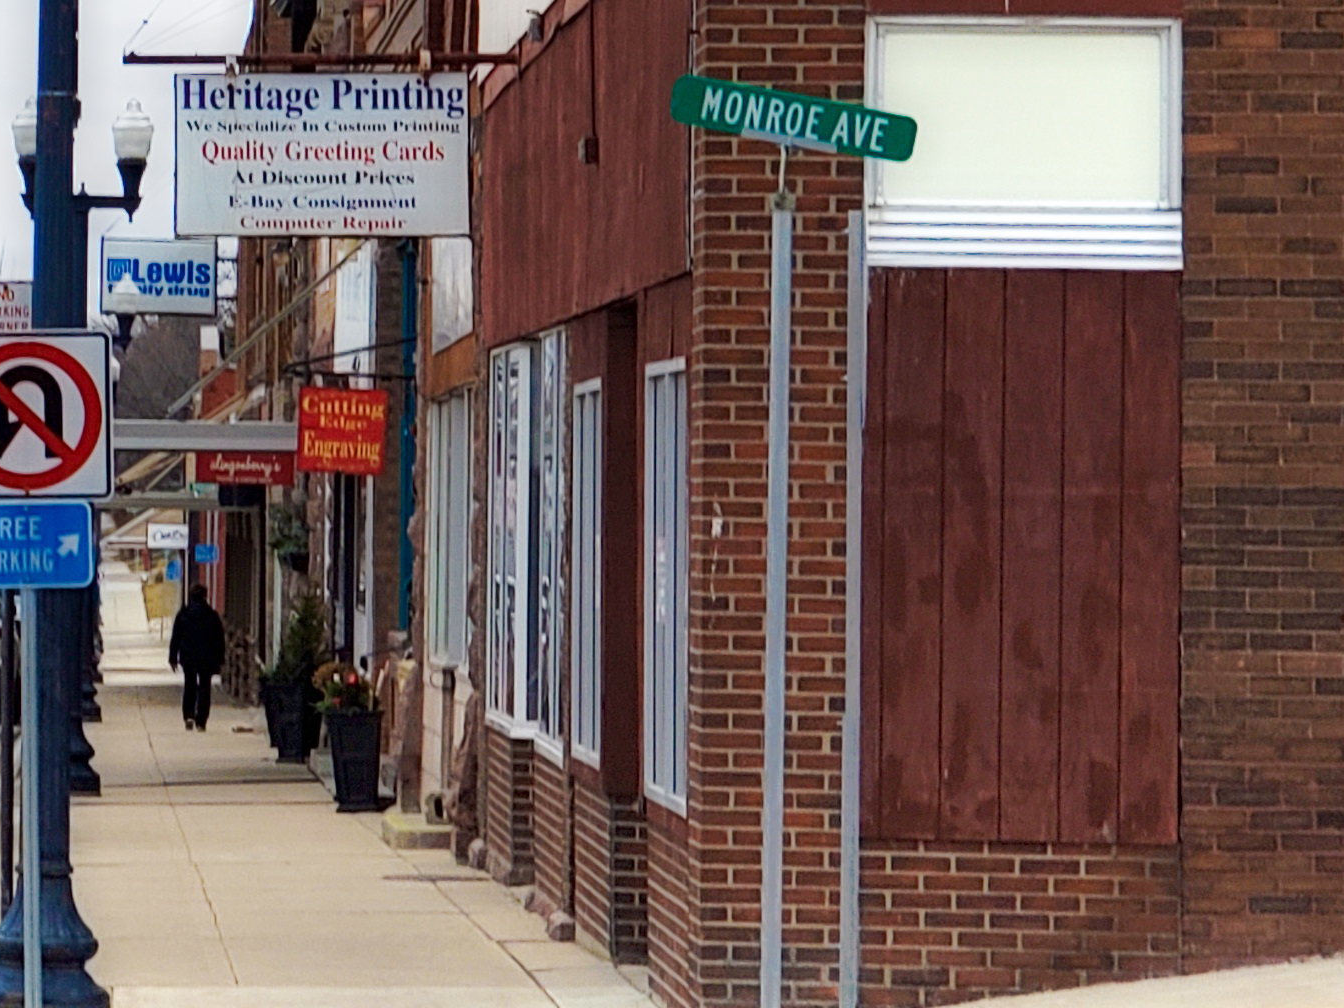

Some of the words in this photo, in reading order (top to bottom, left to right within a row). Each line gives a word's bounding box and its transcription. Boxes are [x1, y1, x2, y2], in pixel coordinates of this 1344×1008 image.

[182, 77, 320, 119] Heritage
[331, 77, 465, 119] Printing
[185, 120, 212, 133] We
[217, 120, 297, 134] Specialize
[302, 120, 319, 133] In
[324, 120, 387, 133] Custom
[393, 119, 461, 134] Printing
[700, 85, 825, 141] MONROE
[830, 111, 890, 152] AVE
[202, 141, 278, 166] Quality
[285, 141, 375, 164] Greeting
[382, 141, 445, 162] Cards
[233, 170, 254, 185] At
[262, 170, 347, 185] Discount
[355, 170, 415, 185] Prices
[229, 195, 284, 211] E-Bay
[293, 195, 416, 211] Consignment
[240, 216, 336, 232] Computer
[342, 216, 407, 232] Repair
[132, 258, 211, 284] Lewis
[303, 395, 385, 421] Cutting
[320, 414, 367, 431] Edge
[304, 430, 381, 469] Engraving
